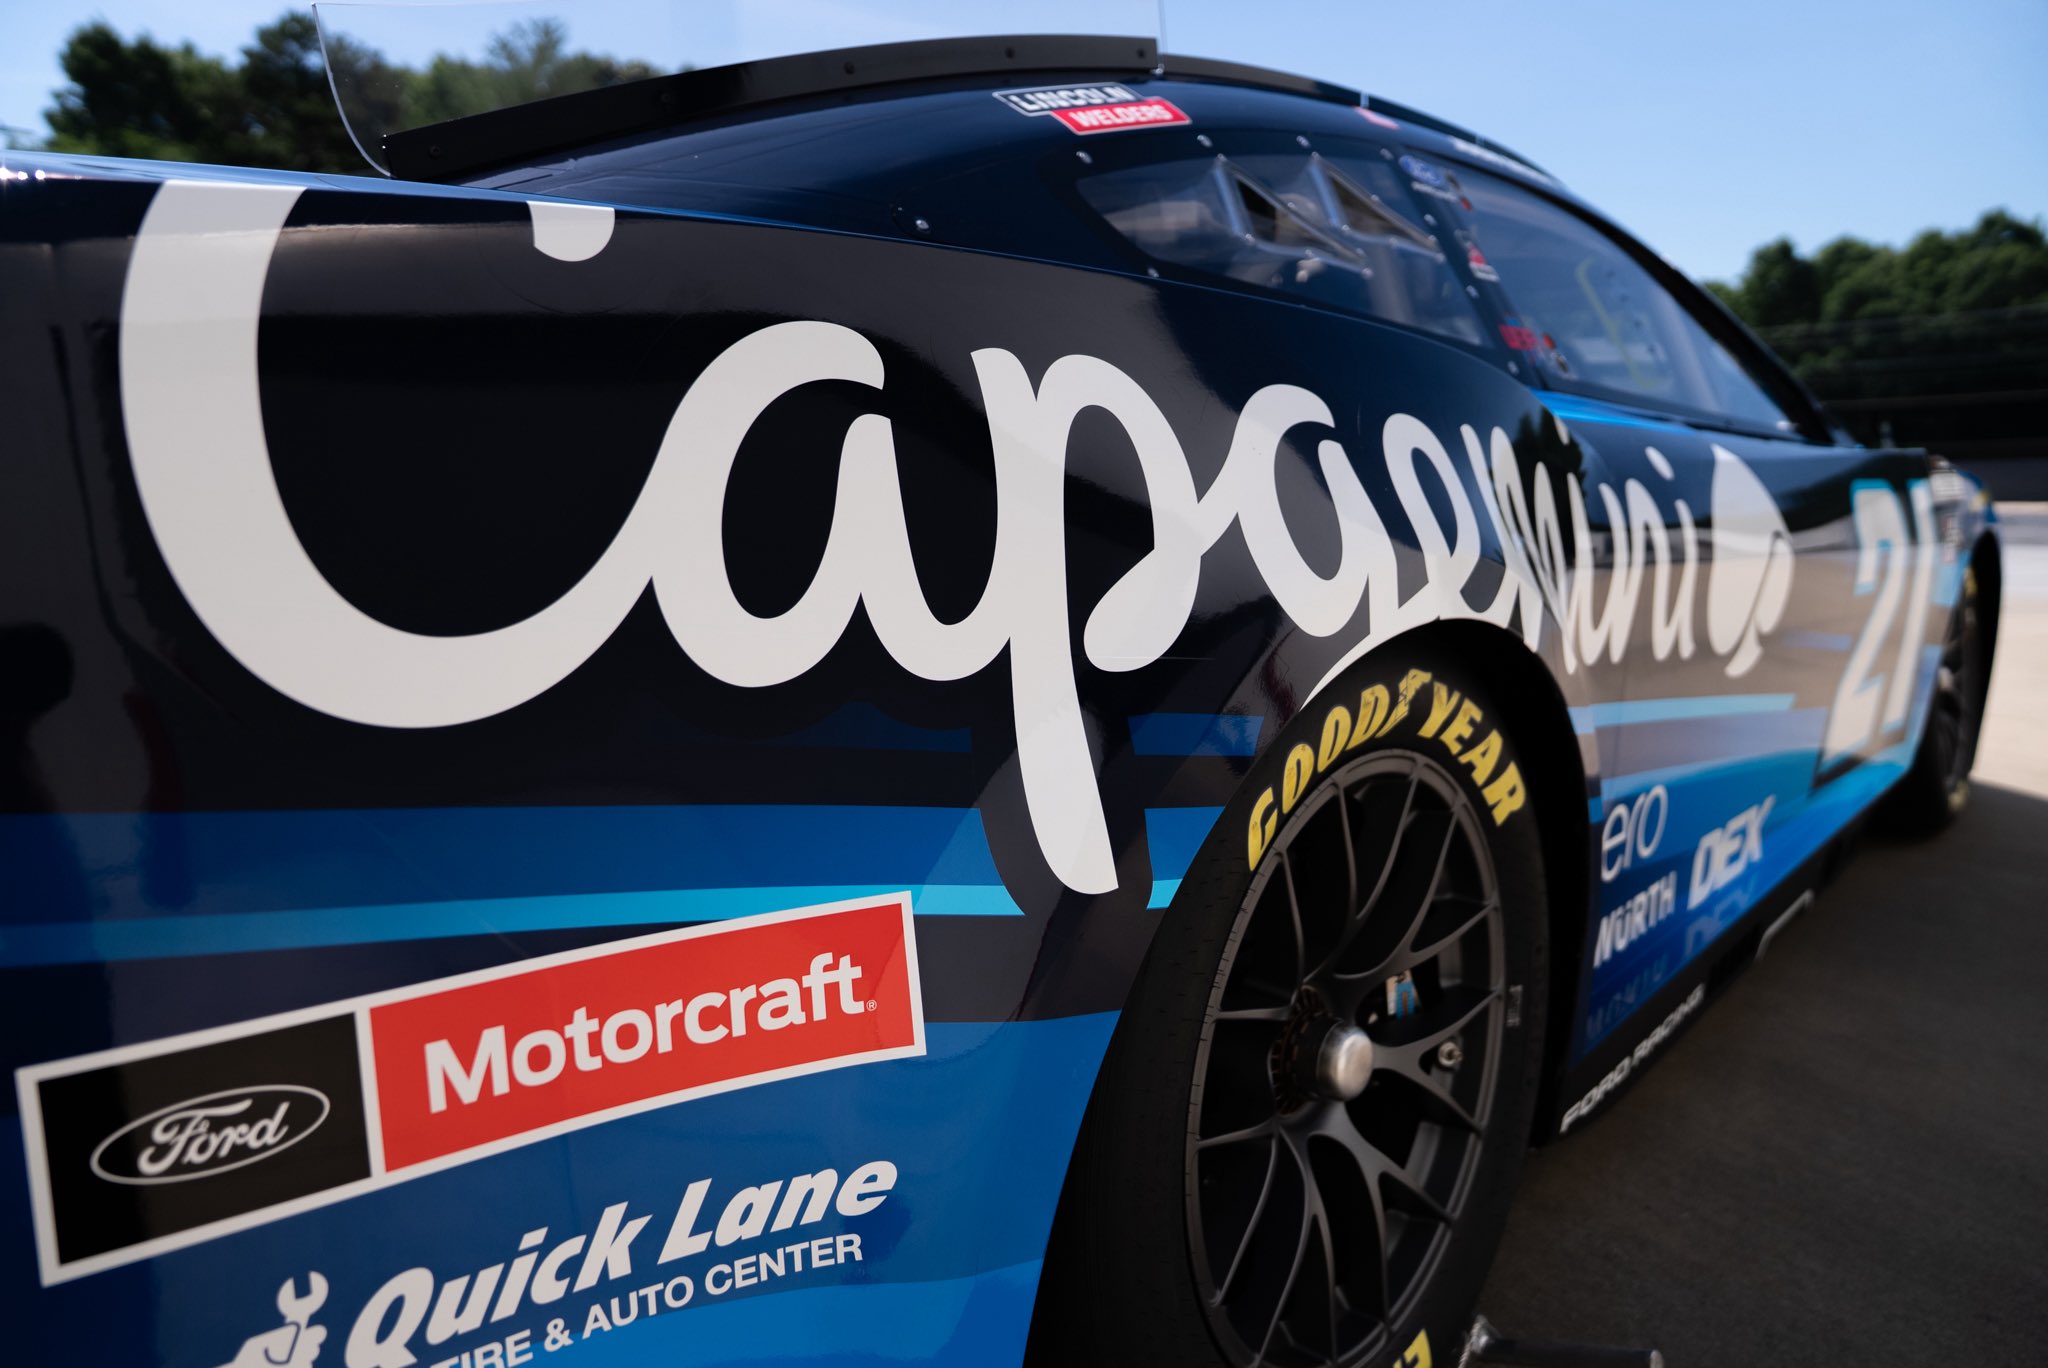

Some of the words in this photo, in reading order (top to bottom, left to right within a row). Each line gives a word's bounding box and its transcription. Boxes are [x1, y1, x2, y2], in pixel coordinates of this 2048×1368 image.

[1007, 86, 1137, 112] LINCOLN
[1068, 104, 1174, 128] WELDERS
[119, 180, 1695, 895] Capgemini
[1822, 478, 1937, 770] 21
[1686, 794, 1776, 910] DEX
[425, 950, 865, 1114] Motorcraft
[137, 1098, 291, 1176] Ford
[1559, 1055, 1632, 1134] FORD
[344, 1201, 653, 1368] Quick
[657, 1160, 898, 1264] Lane
[542, 1319, 575, 1354] &
[582, 1275, 695, 1340] AUTO
[704, 1233, 864, 1296] CENTER
